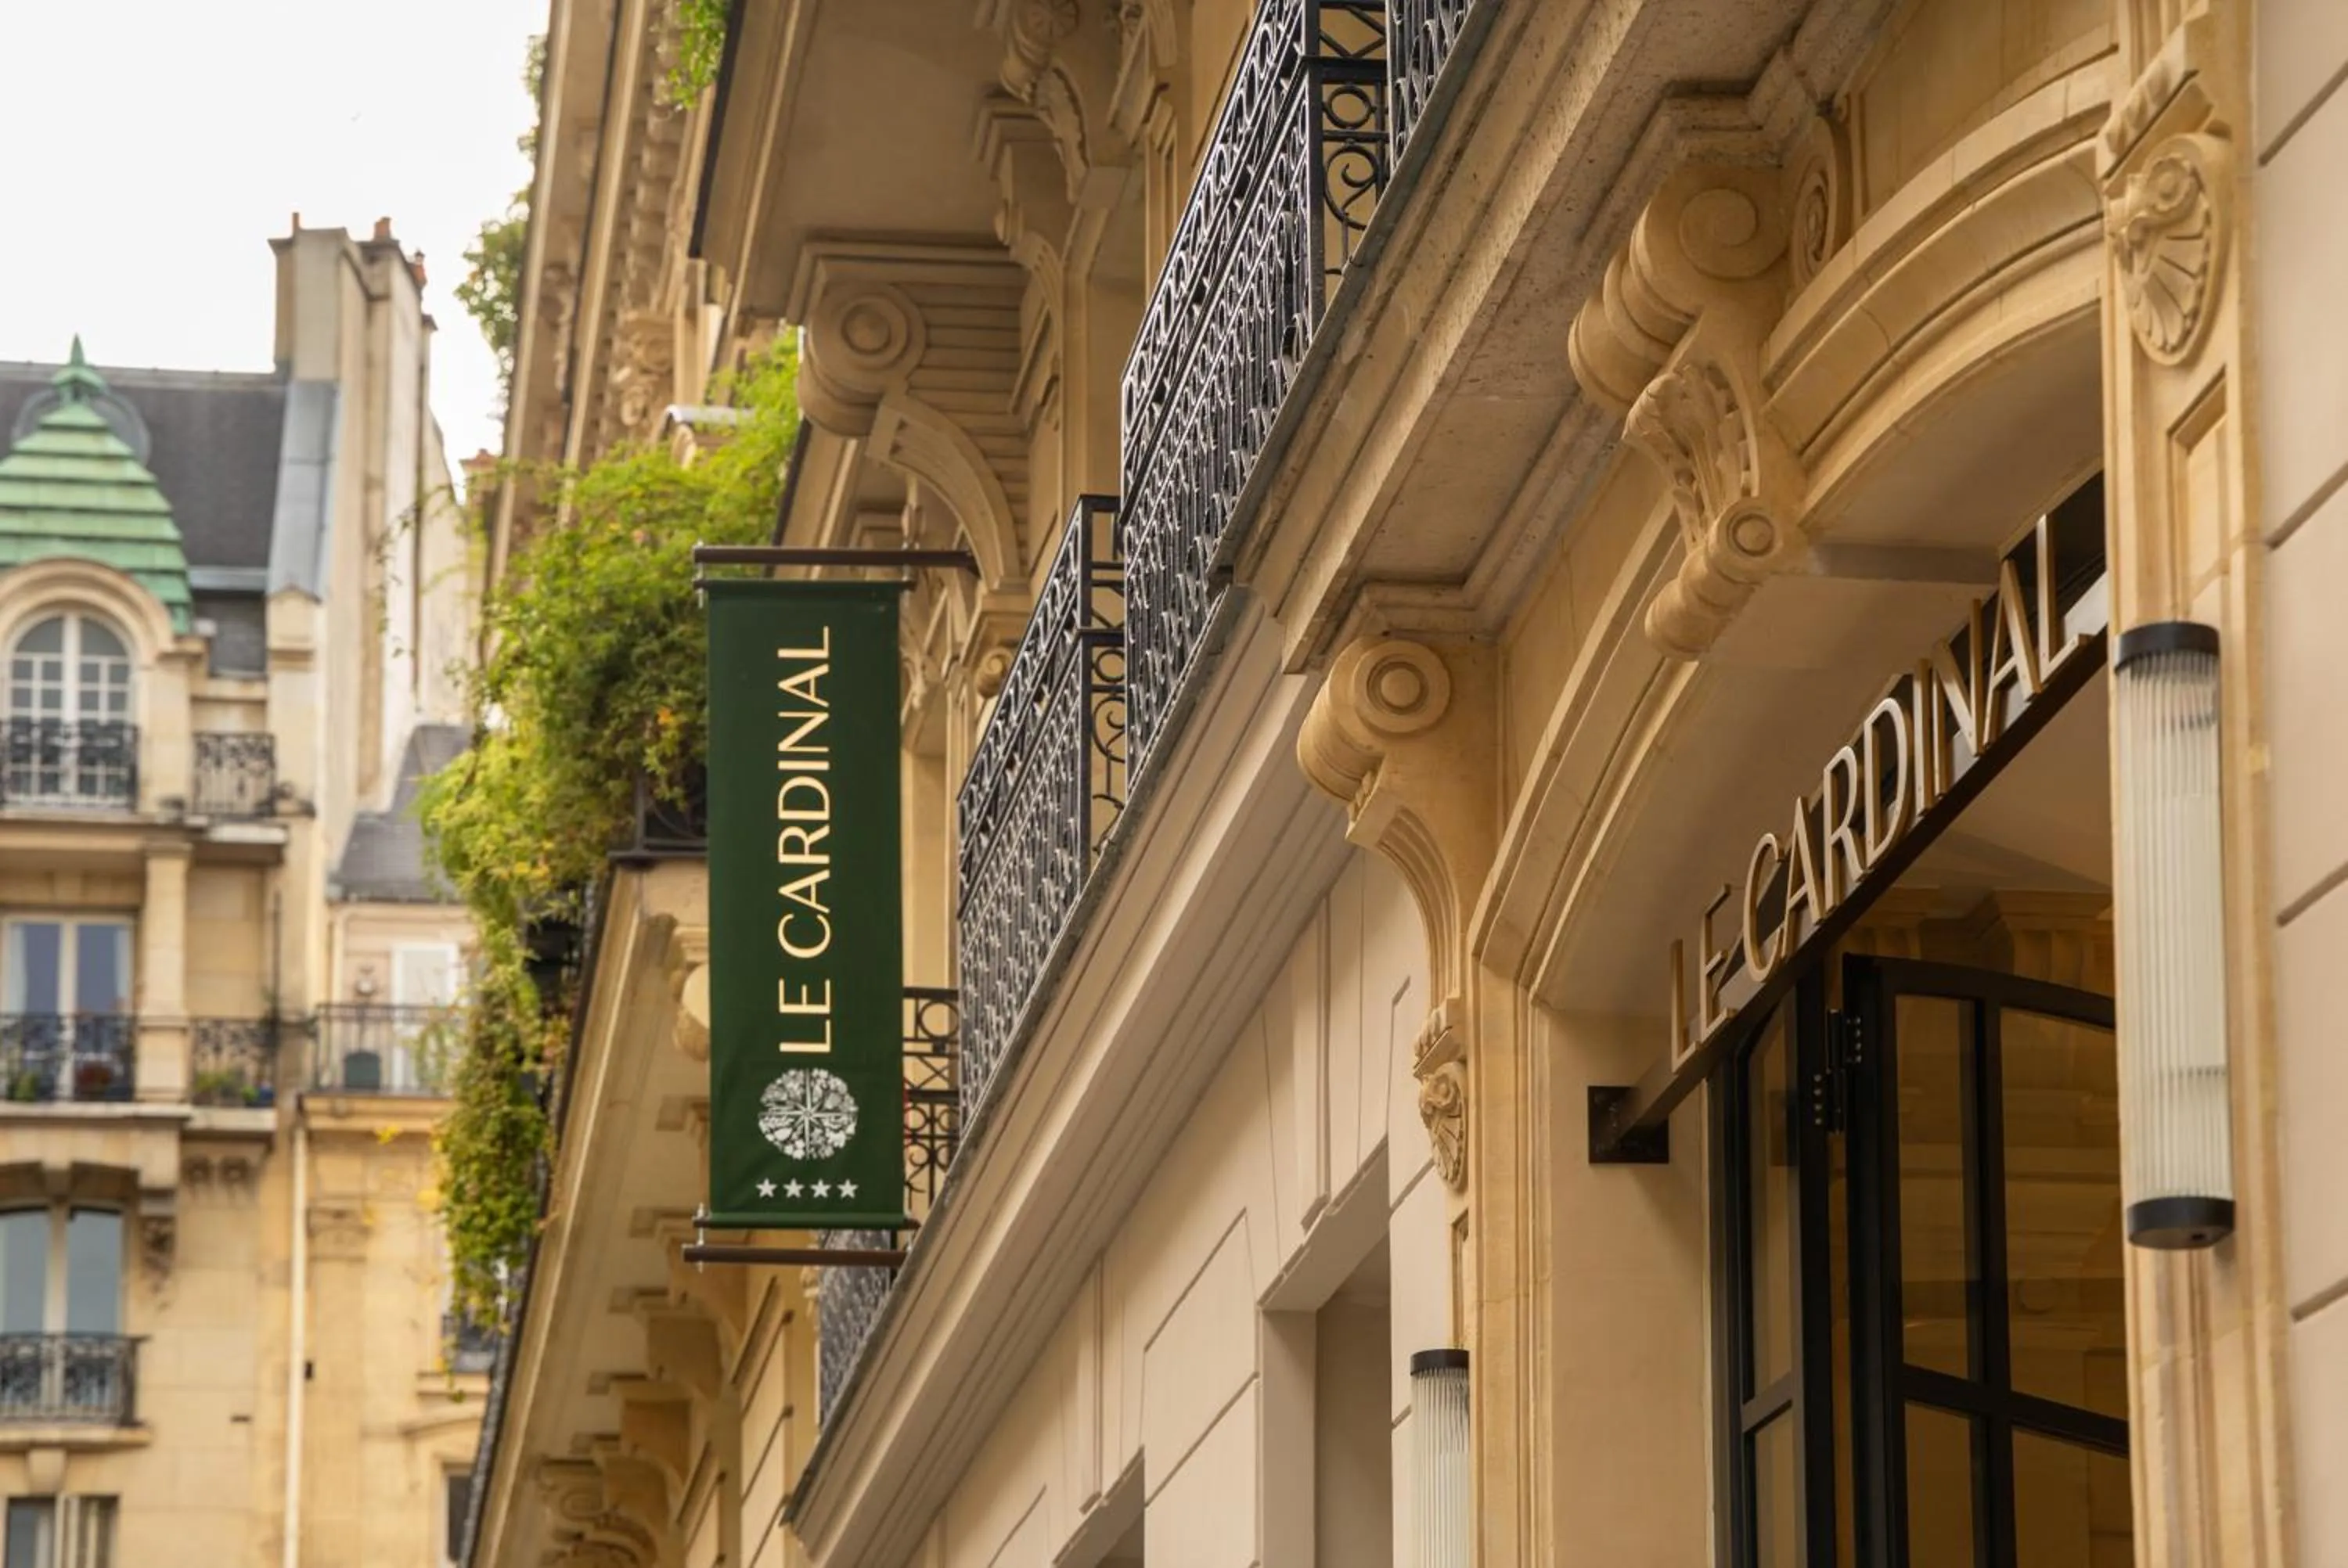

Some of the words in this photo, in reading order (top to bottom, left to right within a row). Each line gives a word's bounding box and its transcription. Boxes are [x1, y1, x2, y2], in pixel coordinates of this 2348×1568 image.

[777, 626, 831, 958] CARDINAL
[1670, 883, 1736, 1074] LE
[1743, 513, 2093, 982] CARDINAL
[779, 978, 831, 1053] LE
